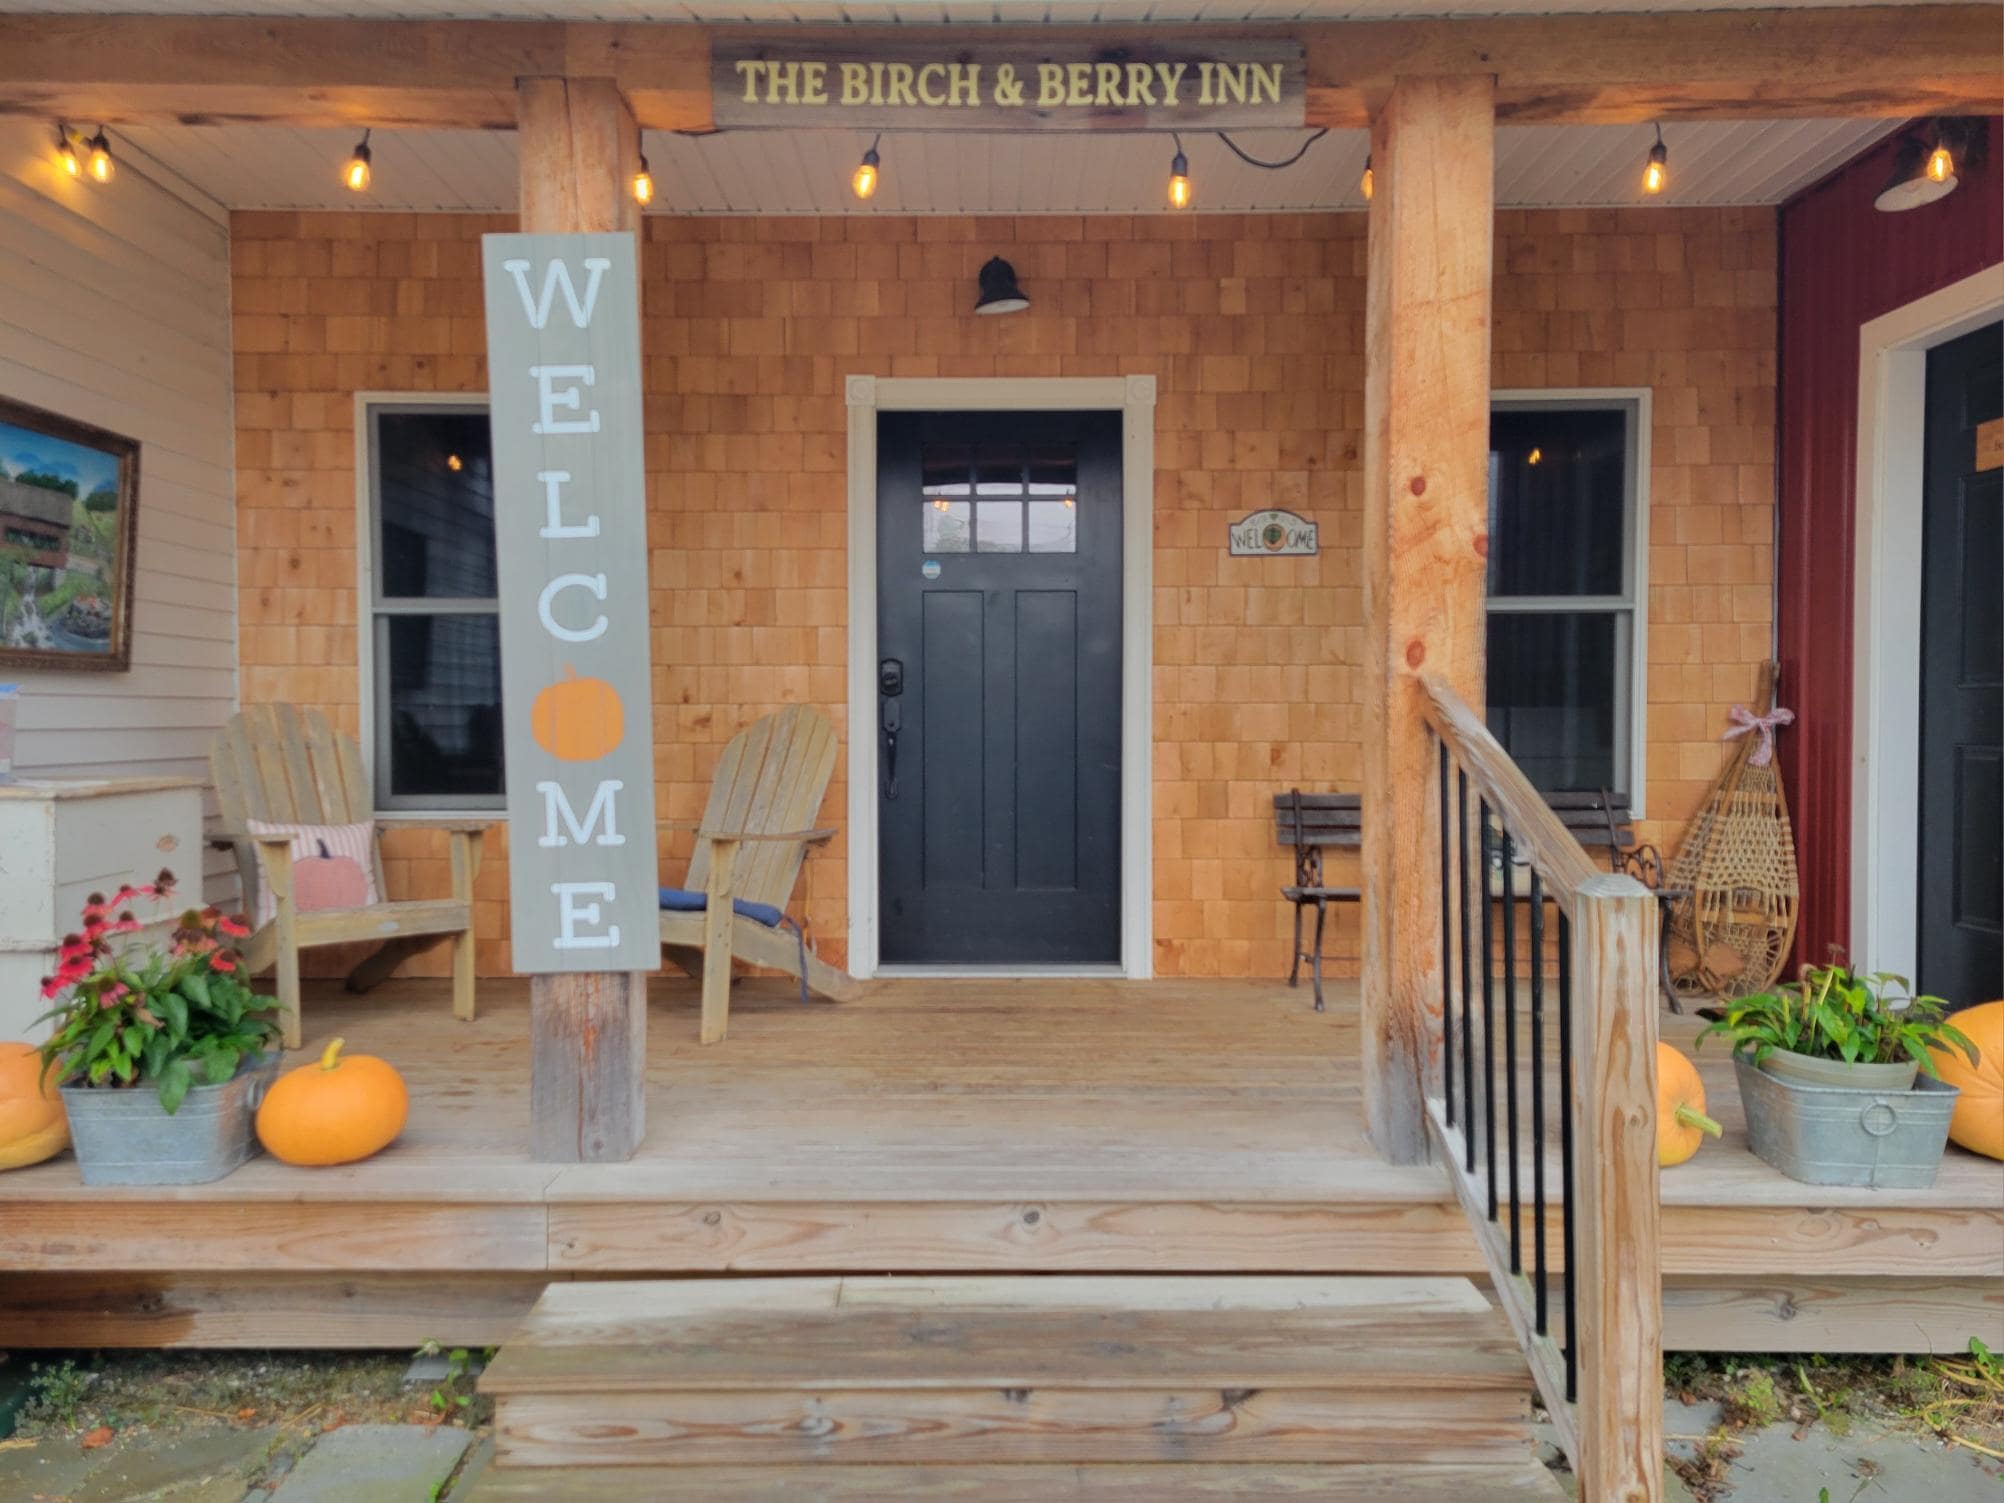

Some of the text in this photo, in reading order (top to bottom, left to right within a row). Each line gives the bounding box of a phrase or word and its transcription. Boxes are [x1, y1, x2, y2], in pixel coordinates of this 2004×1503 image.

[735, 60, 1284, 107] THE BIRCH & BERRY INN
[1231, 525, 1314, 550] WELOME
[503, 257, 626, 950] WELCME
